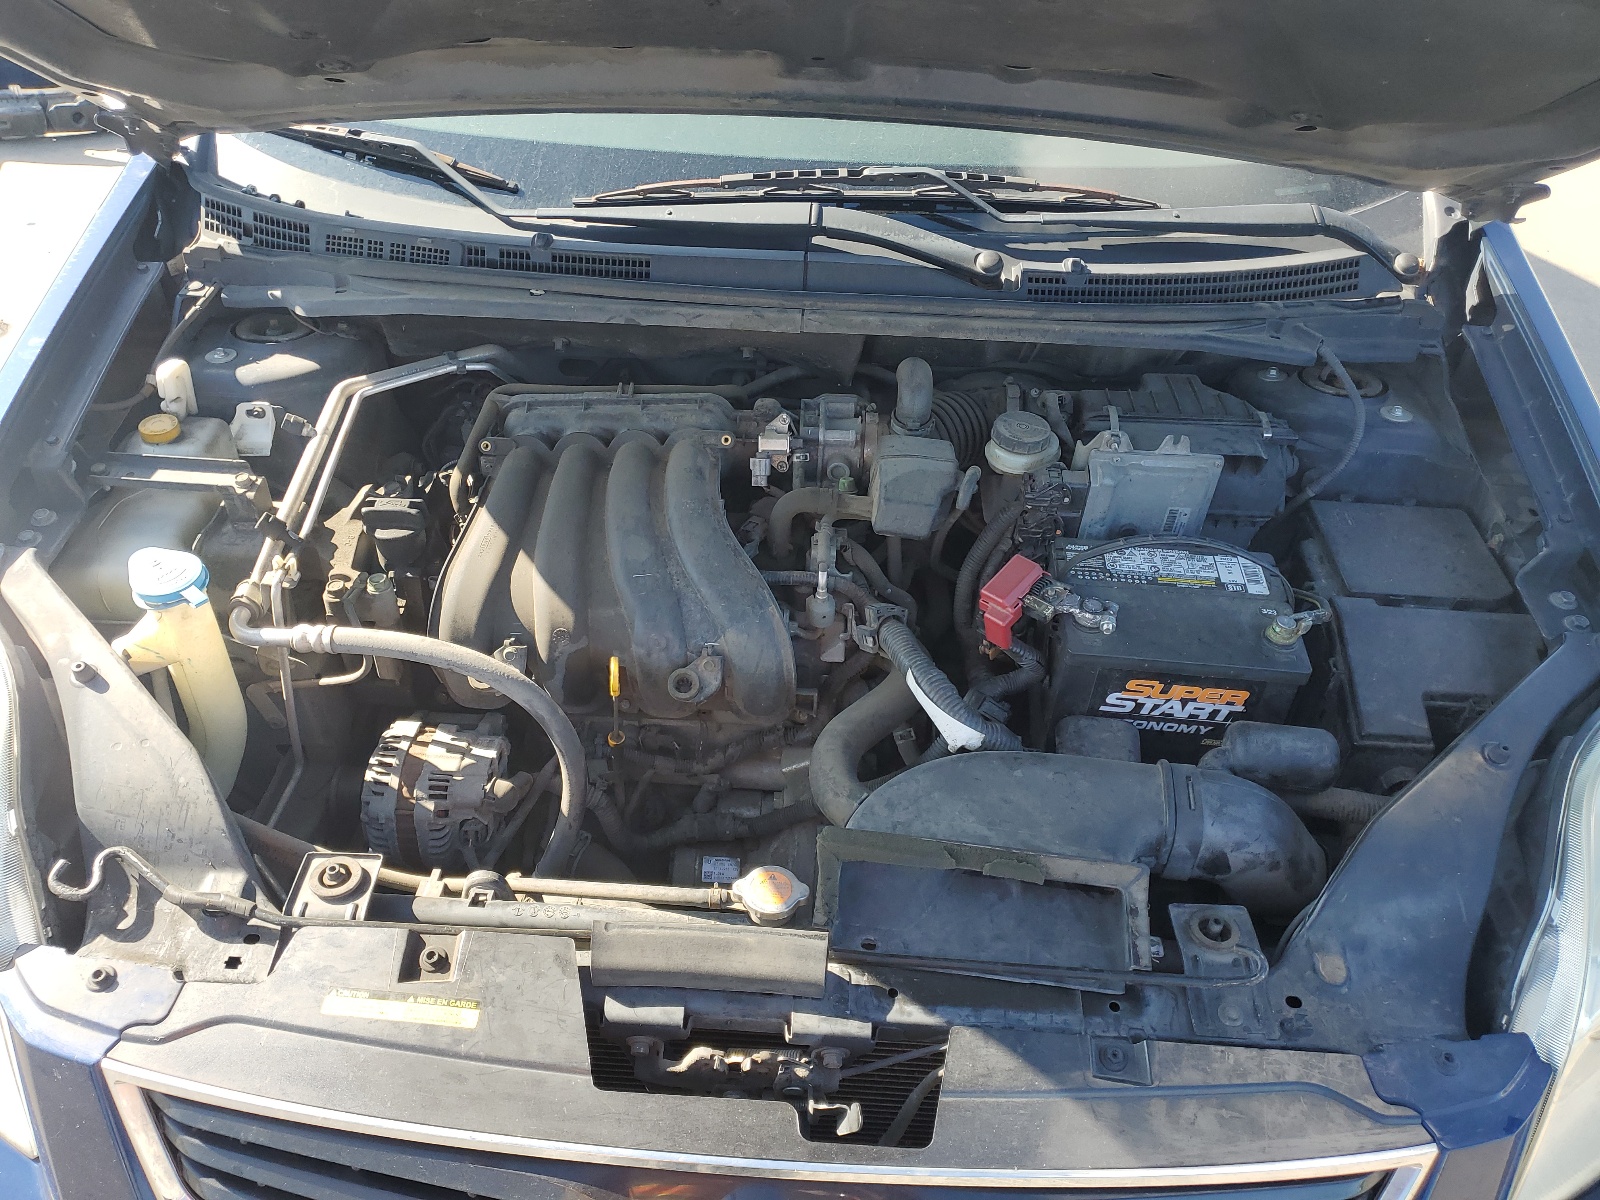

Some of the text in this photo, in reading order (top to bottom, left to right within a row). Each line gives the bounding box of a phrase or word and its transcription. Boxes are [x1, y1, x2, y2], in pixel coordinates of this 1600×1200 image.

[1261, 608, 1277, 616] 3/23
[1122, 679, 1250, 706] SUPER
[1099, 692, 1245, 722] START
[1123, 719, 1214, 735] ONOMY
[417, 996, 477, 1009] MISE EN GARDE
